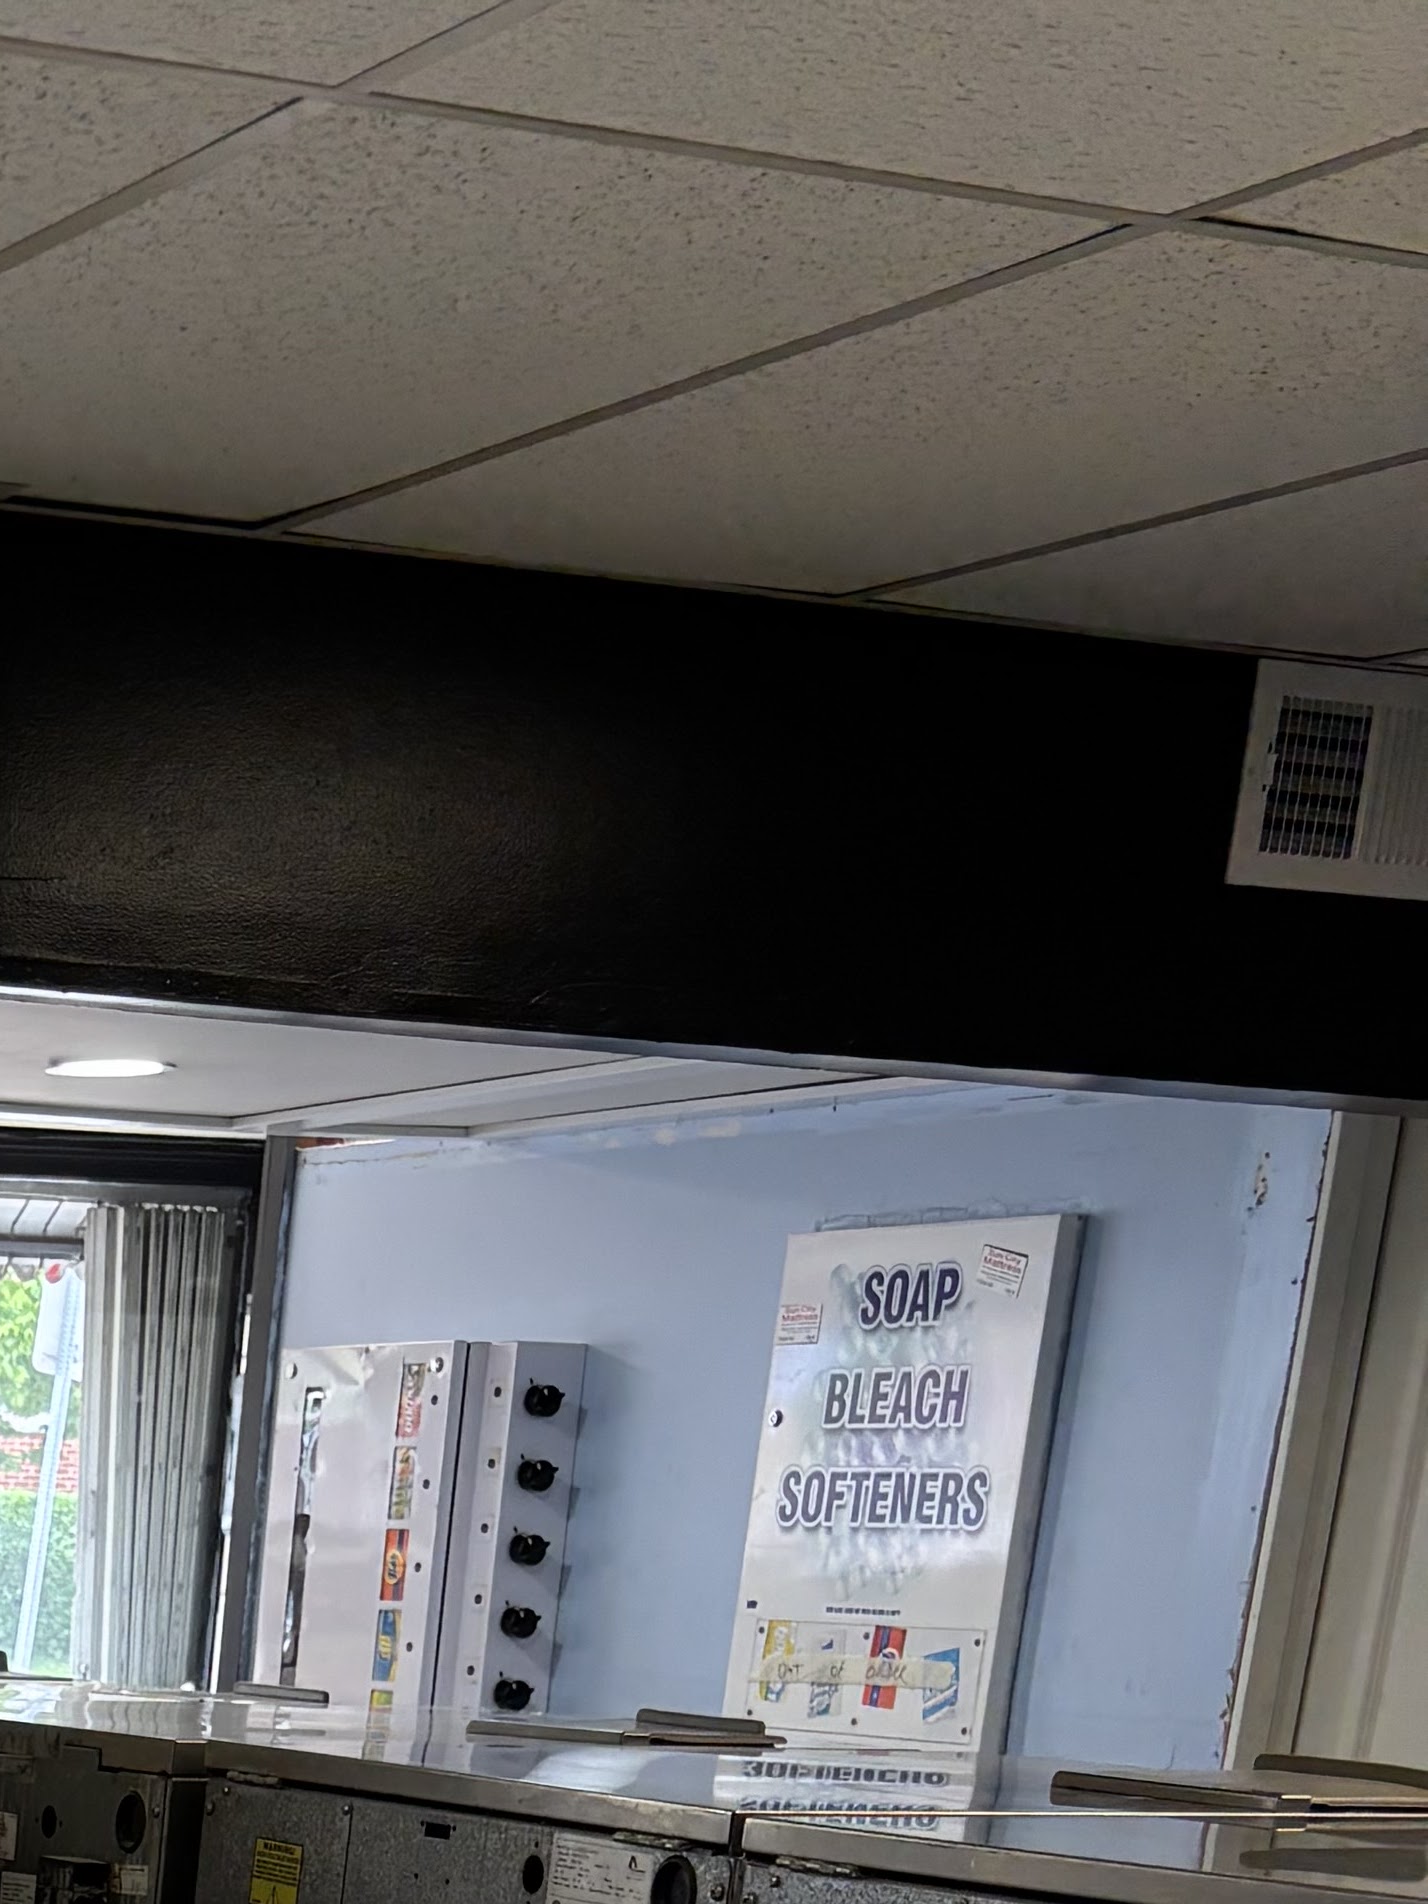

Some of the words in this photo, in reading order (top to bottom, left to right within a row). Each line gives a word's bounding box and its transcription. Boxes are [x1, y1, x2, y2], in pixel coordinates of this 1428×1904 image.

[859, 1265, 961, 1325] SOAP
[822, 1368, 970, 1426] BLEACH
[776, 1468, 989, 1528] SOFTENERS
